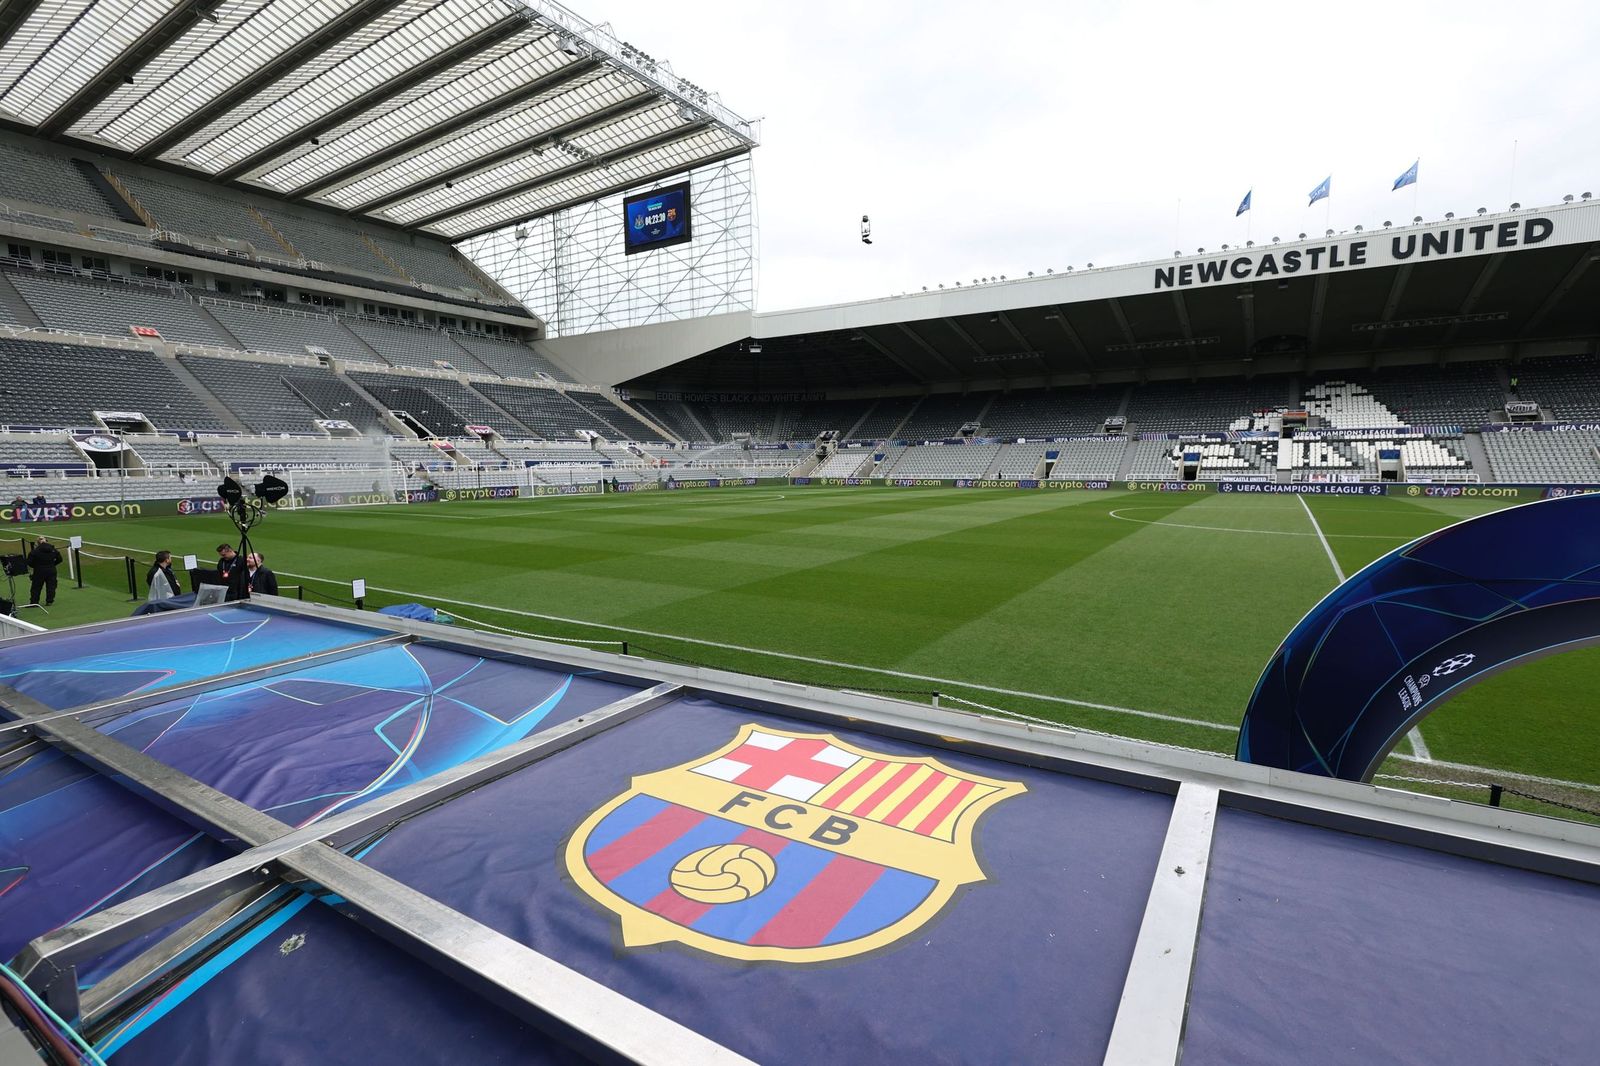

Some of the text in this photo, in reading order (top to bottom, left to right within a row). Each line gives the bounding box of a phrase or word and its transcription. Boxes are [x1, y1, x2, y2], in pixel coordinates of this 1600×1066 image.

[1154, 217, 1554, 290] NEWCASTLE UNITED
[656, 391, 682, 401] EDDIE
[720, 393, 750, 402] BLACK
[1551, 424, 1577, 432] UEFA
[260, 463, 284, 471] UEFA
[286, 462, 338, 471] CHAMPIONS
[828, 478, 872, 487] crypto.com
[967, 480, 1020, 489] crypto.com
[1049, 480, 1108, 490] crypto.com
[1140, 481, 1206, 492] crypto.com
[460, 487, 520, 501] crypto.com
[1237, 484, 1364, 494] UEFA CHAMPIONS LEAGUE
[1424, 484, 1518, 498] crypto.com
[0, 503, 141, 521] crypto.com
[1403, 674, 1423, 707] CHAMPIONS
[1397, 687, 1412, 711] LEAGUE
